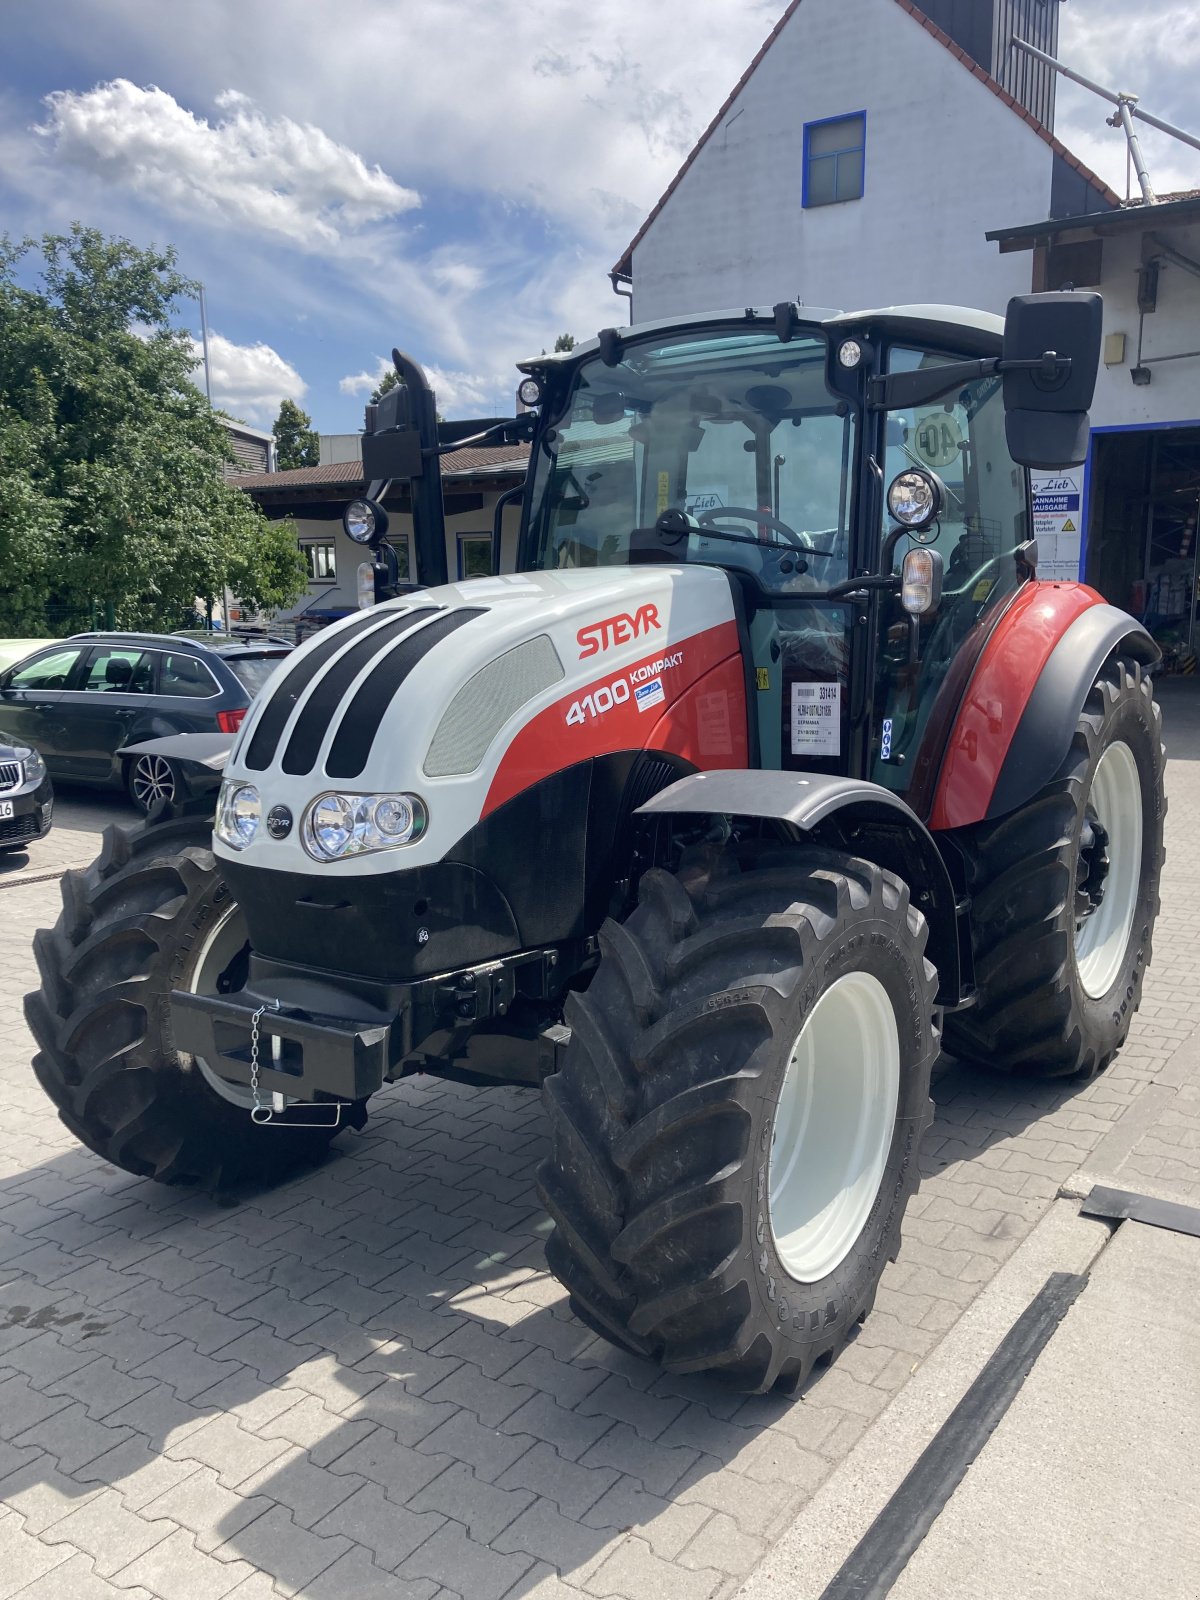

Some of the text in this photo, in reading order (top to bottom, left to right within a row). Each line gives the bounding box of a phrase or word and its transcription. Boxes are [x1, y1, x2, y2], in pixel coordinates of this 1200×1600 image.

[1041, 479, 1069, 492] Lieb
[693, 496, 716, 508] Lieb
[576, 603, 662, 660] STEYR
[565, 678, 630, 727] 4100
[629, 651, 683, 685] KOMPAKT
[267, 817, 290, 827] STEYR
